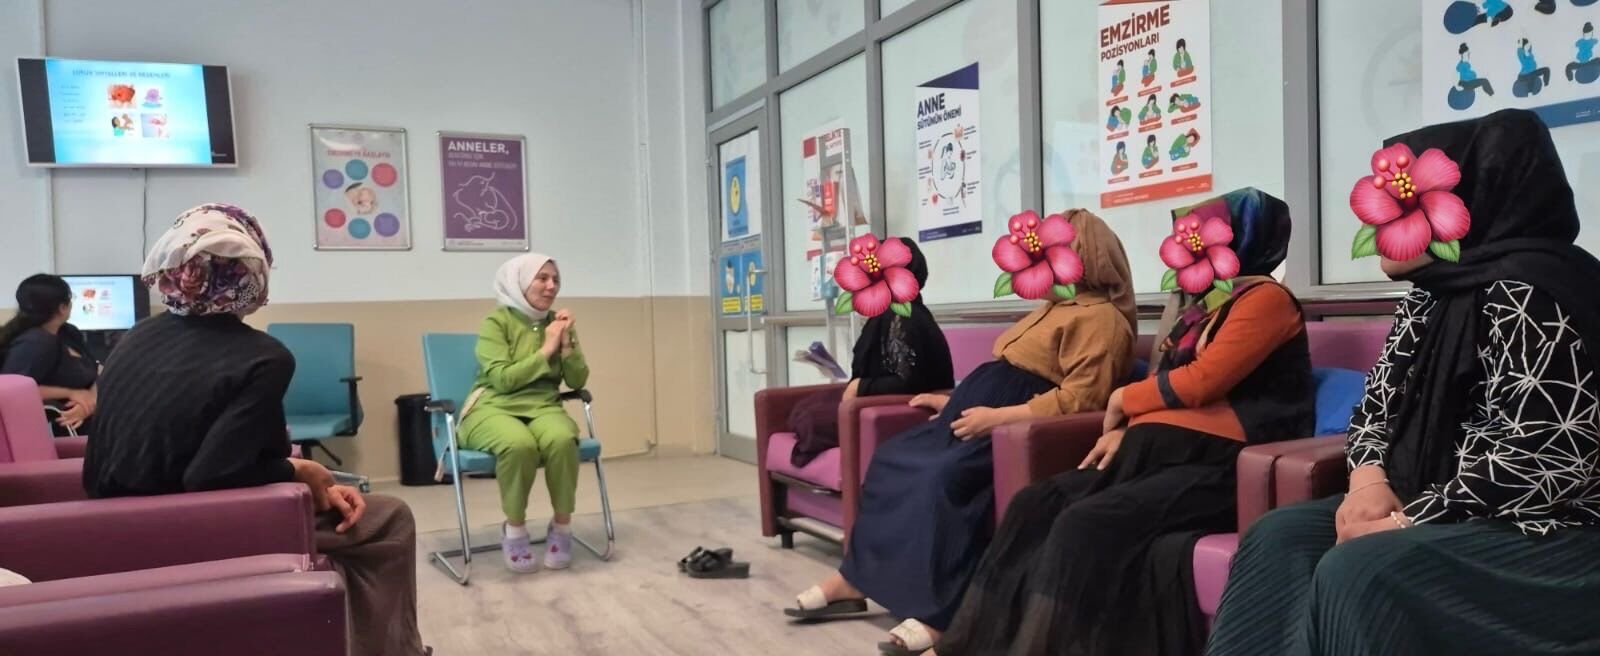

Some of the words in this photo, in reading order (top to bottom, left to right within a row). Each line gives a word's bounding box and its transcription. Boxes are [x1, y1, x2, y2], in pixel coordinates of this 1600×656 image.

[1100, 4, 1170, 48] EMZİRME
[1101, 32, 1159, 62] POZİSYONLARI
[917, 93, 945, 118] ANNE
[448, 141, 509, 155] ANNELER,
